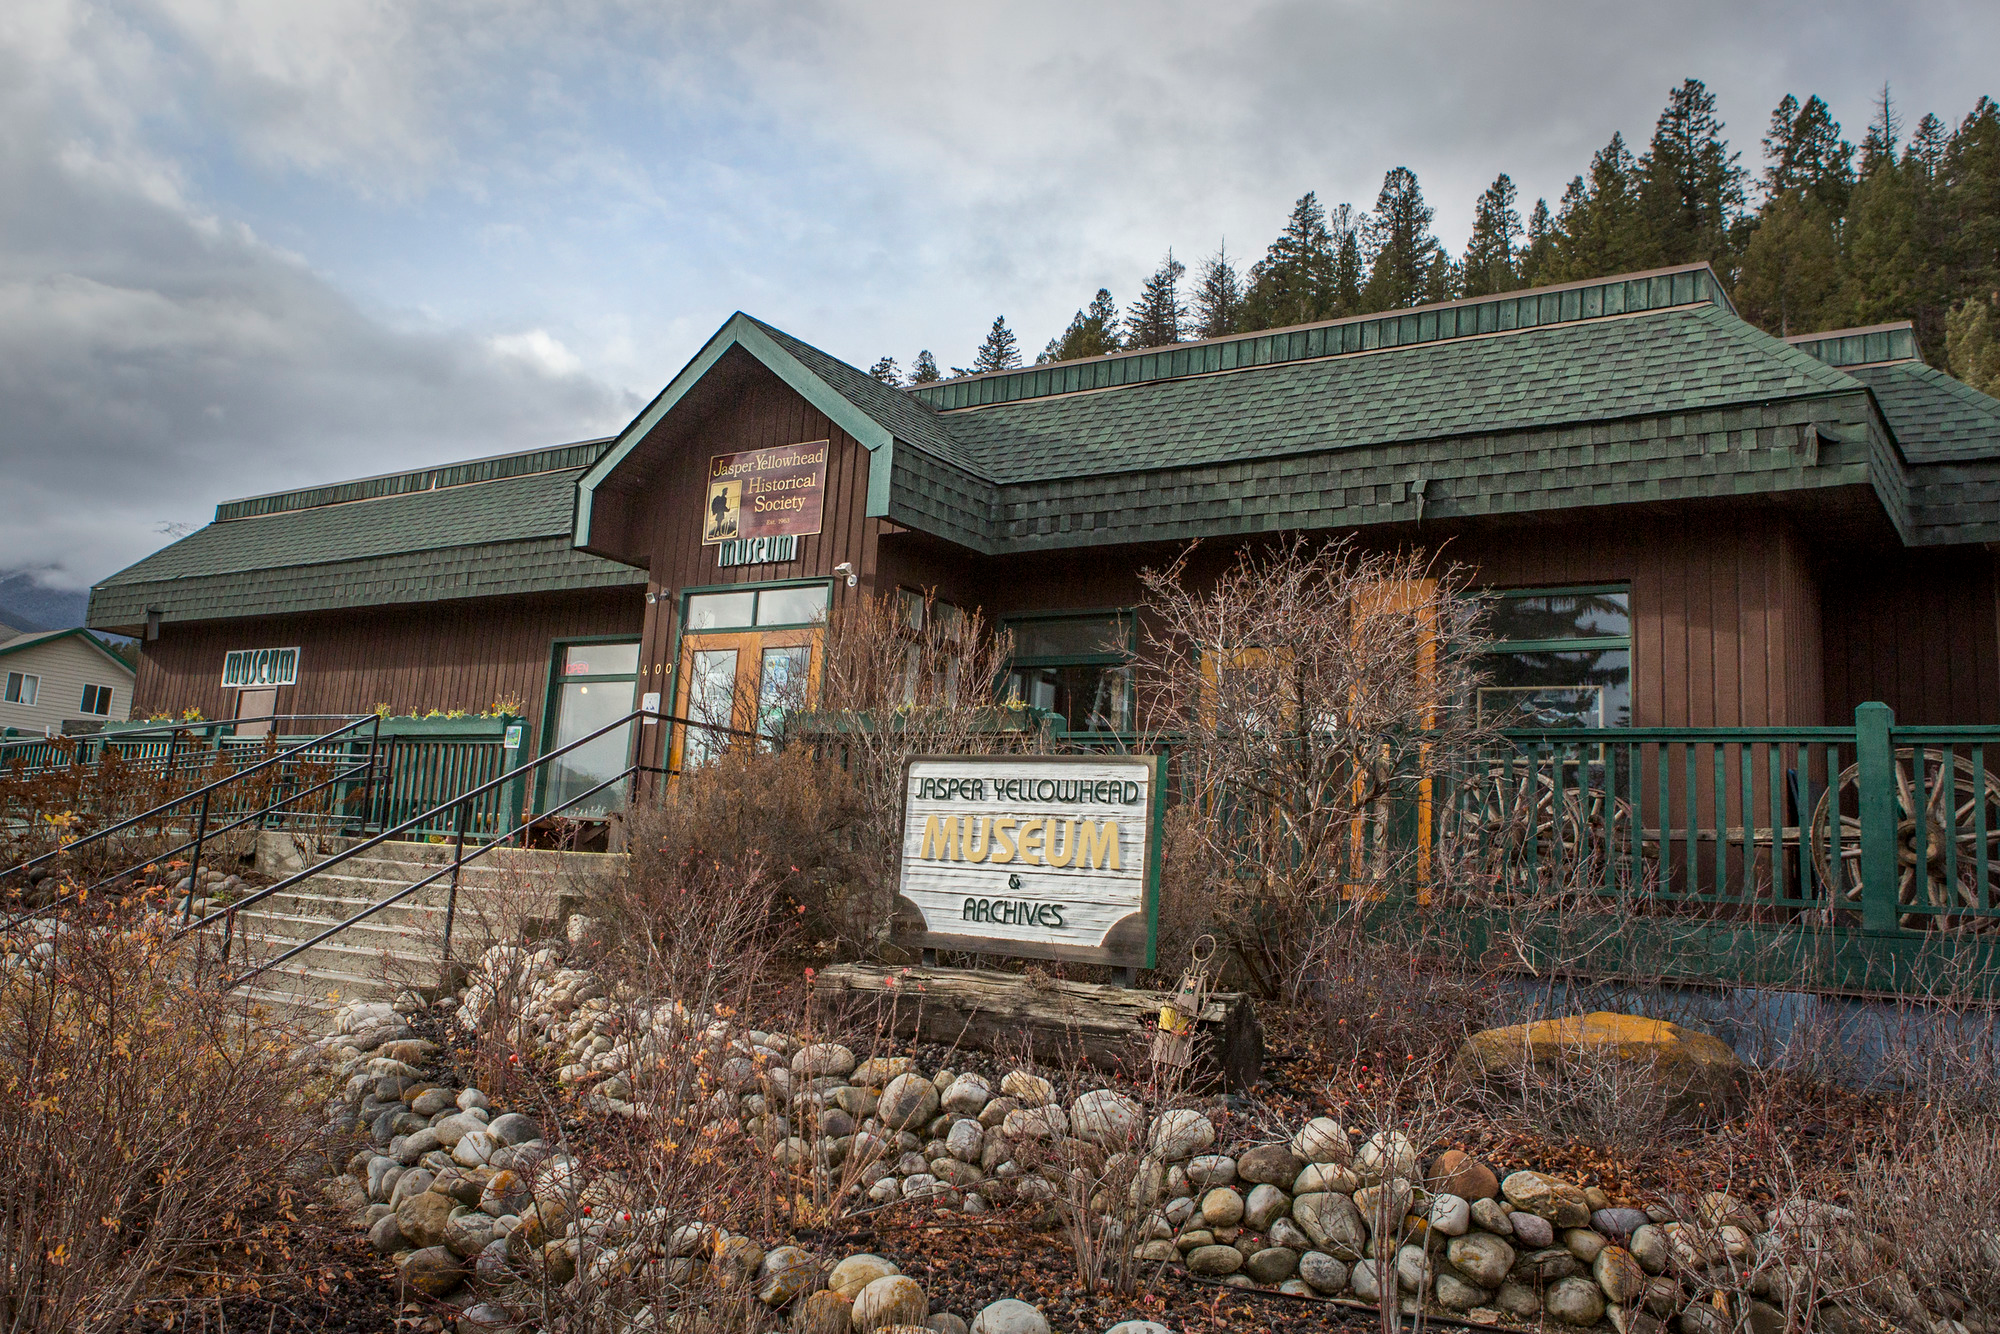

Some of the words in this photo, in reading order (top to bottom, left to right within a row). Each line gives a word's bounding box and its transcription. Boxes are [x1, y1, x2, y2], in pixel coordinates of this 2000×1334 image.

[748, 472, 816, 494] Historical
[754, 496, 806, 513] Society
[566, 663, 589, 674] OPEN
[916, 777, 984, 800] JASPER
[993, 778, 1140, 804] YELLOWHEAD
[920, 815, 1120, 869] MUSEUM
[1008, 873, 1021, 890] &
[963, 897, 1064, 928] ARCHIVES
